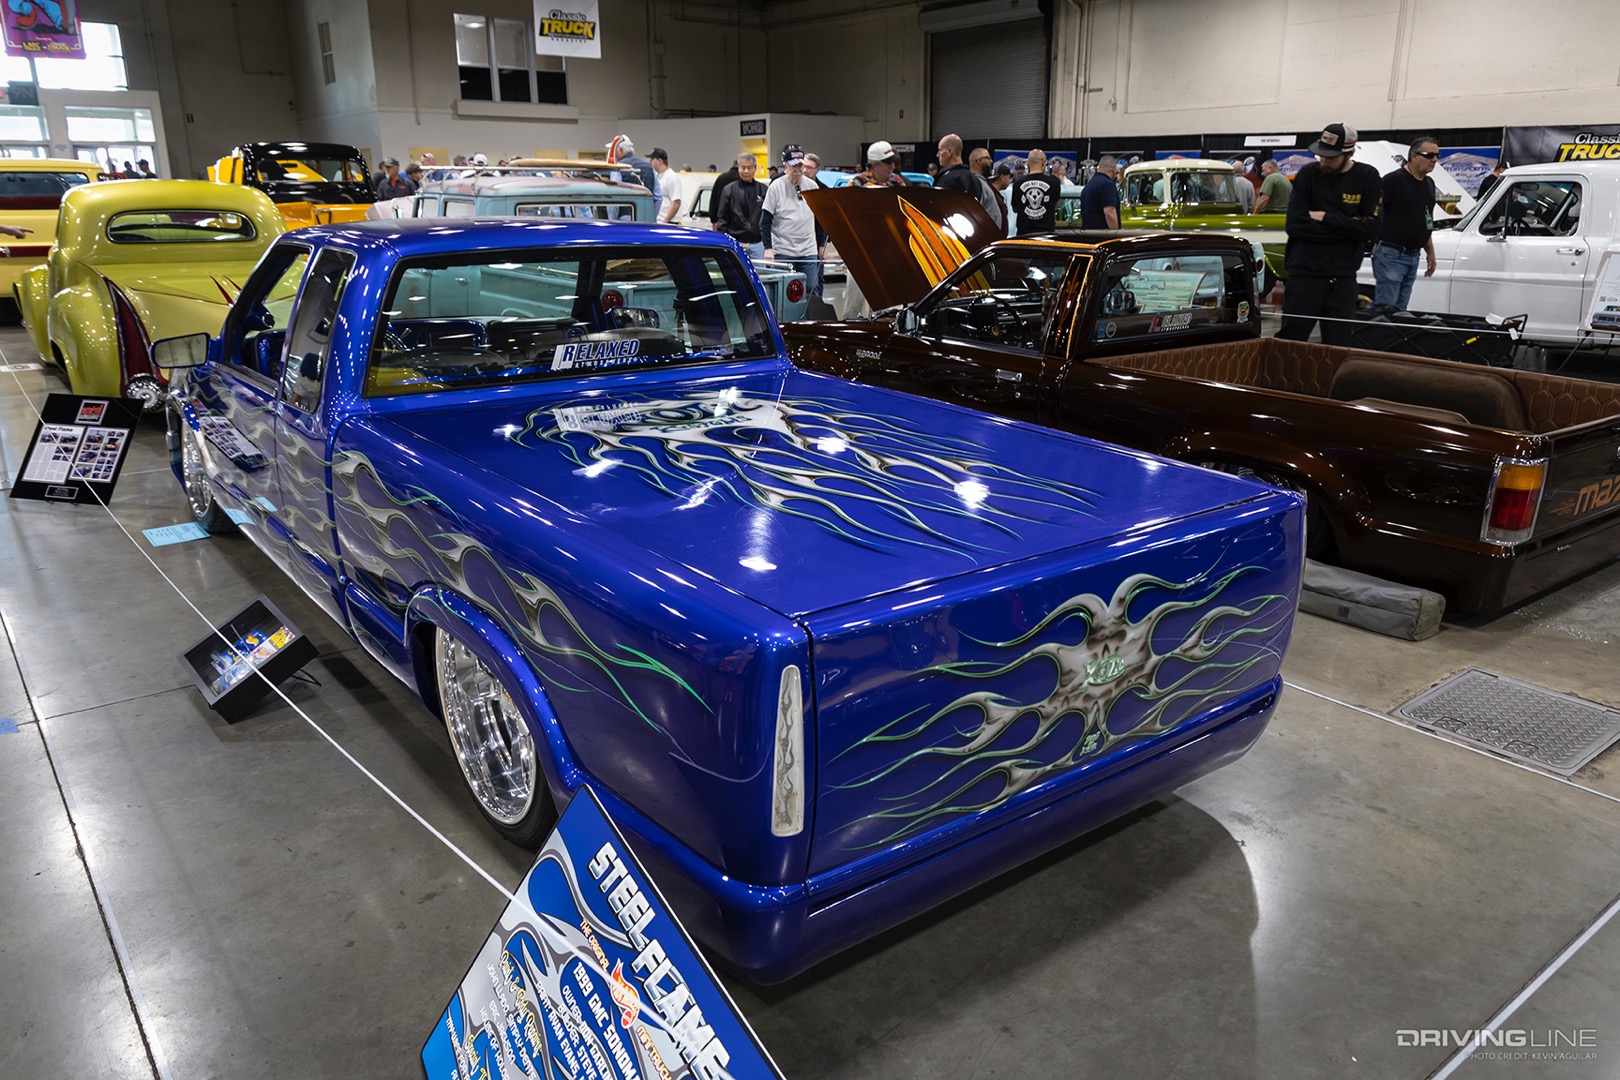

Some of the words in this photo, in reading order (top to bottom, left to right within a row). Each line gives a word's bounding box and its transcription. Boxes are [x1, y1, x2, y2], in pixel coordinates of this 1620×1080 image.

[541, 19, 594, 39] TRUCK
[549, 9, 587, 21] Classic
[562, 339, 639, 363] RELAXED
[588, 841, 656, 951] STEEL
[580, 918, 593, 937] THE
[587, 934, 610, 973] ORIGINAL
[480, 1006, 494, 1039] HOUSE
[490, 1039, 499, 1051] OF
[487, 963, 500, 990] JOHN
[507, 1013, 523, 1049] SIMPLY
[489, 1000, 500, 1020] ERIC
[497, 1021, 515, 1065] JACKSON
[557, 1003, 579, 1047] BUILDER:
[573, 961, 594, 997] 1999
[587, 993, 610, 1028] GMC
[603, 1024, 640, 1080] SONOM
[446, 1017, 455, 1033] MY
[451, 1033, 462, 1055] WIFE
[457, 1055, 468, 1075] FOR
[547, 1011, 564, 1041] RYAN
[560, 1038, 580, 1079] EVANS,
